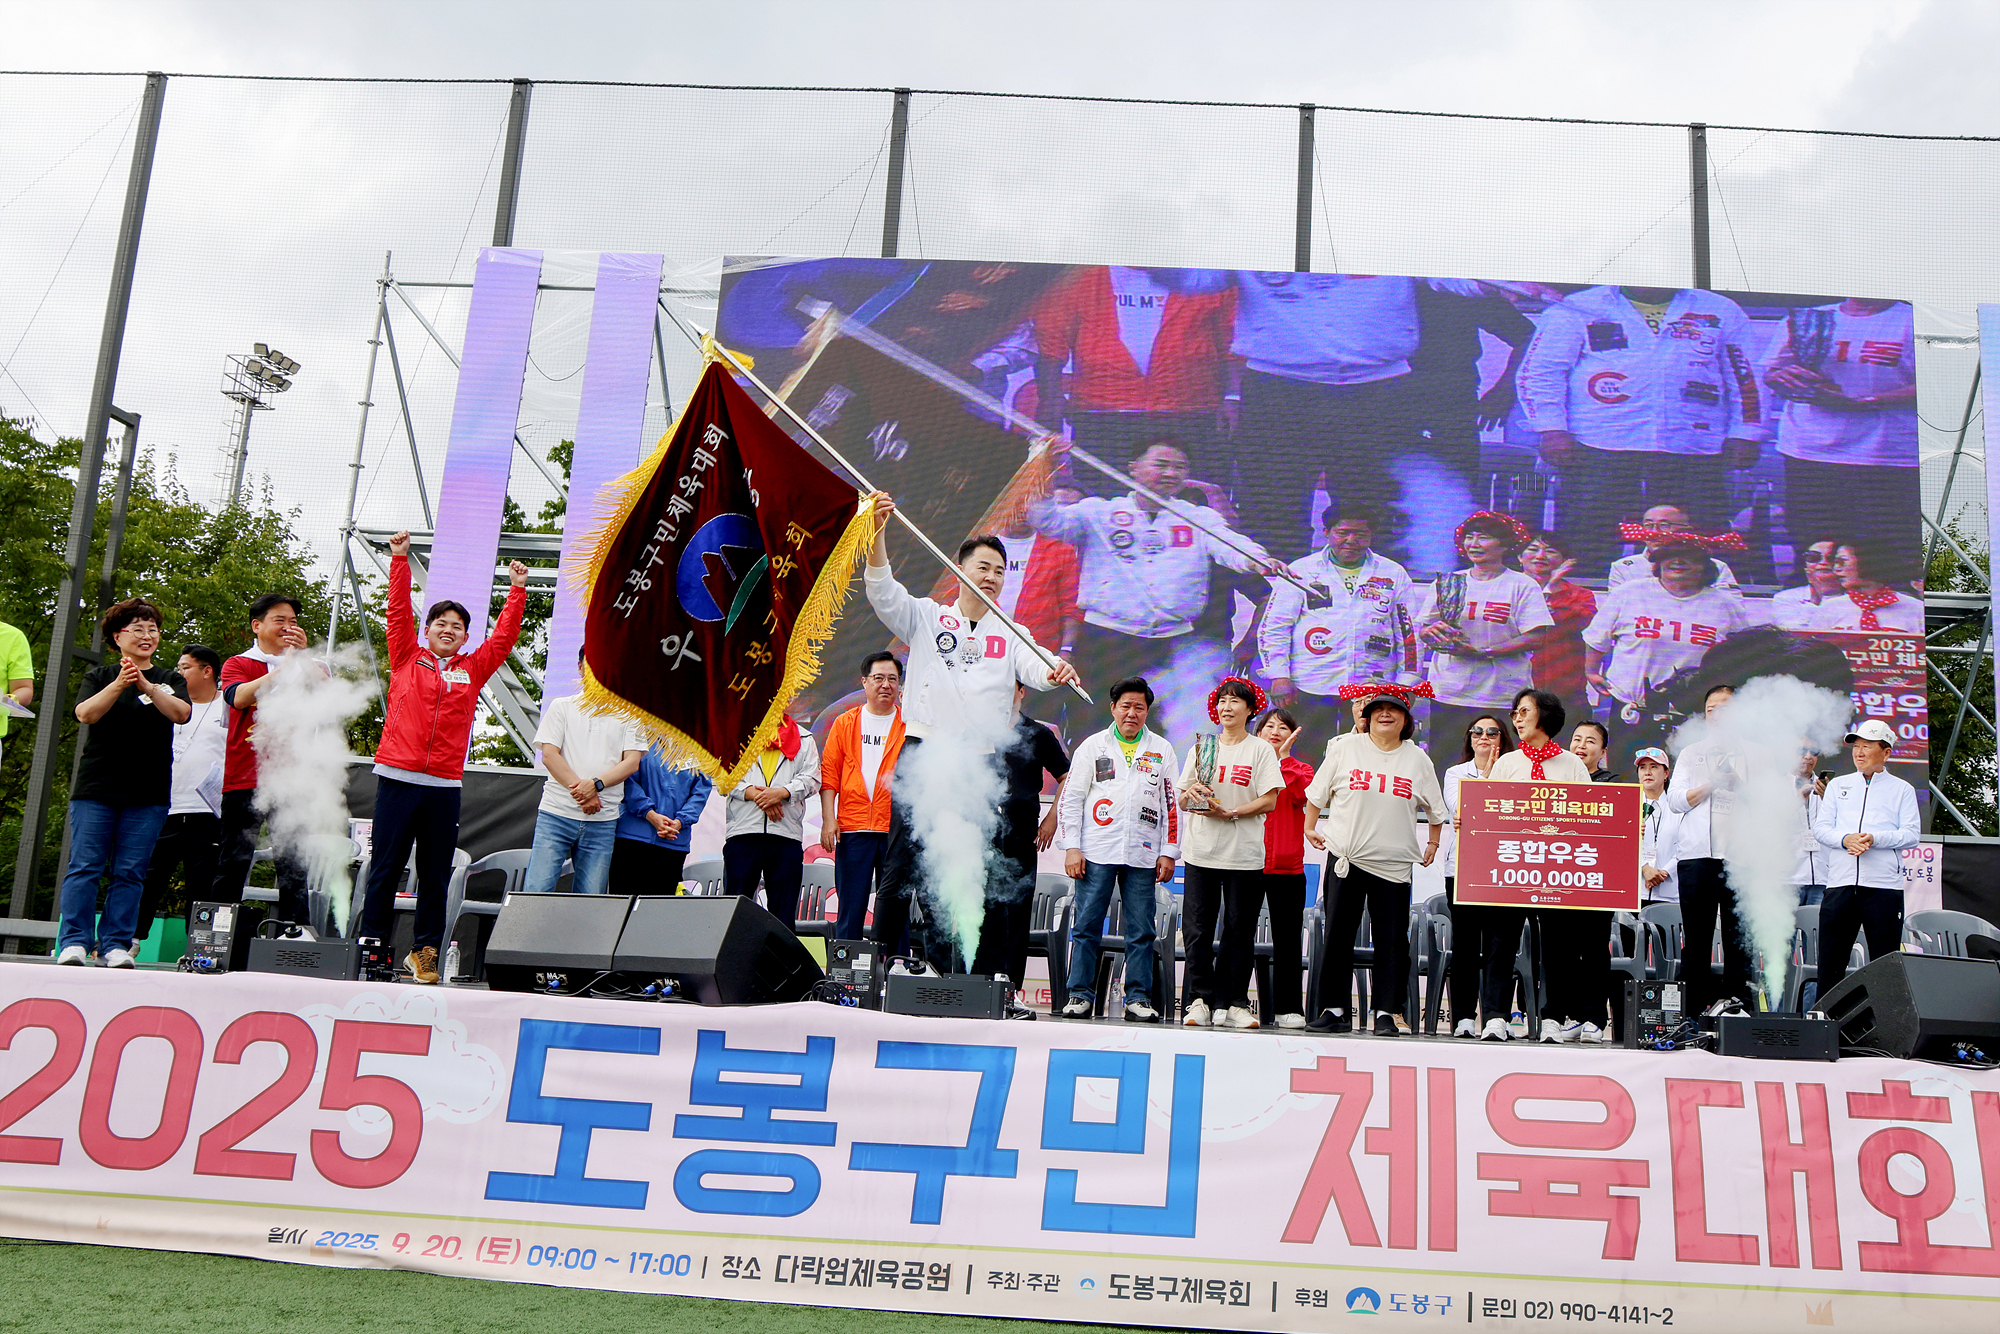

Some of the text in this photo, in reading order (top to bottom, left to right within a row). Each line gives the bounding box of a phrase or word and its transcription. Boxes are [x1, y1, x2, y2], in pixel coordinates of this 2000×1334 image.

[1835, 341, 1903, 367] 1동
[613, 423, 729, 618] 도봉구민체육대회
[1466, 601, 1511, 625] 1동
[1634, 616, 1717, 647] 창1동
[984, 635, 1007, 659] D
[1867, 639, 1918, 652] 2025
[1217, 764, 1253, 788] 1동
[1349, 768, 1413, 800] 창1동
[1530, 787, 1568, 800] 2025
[1484, 799, 1614, 817] 도봉구민 체육대회
[1497, 840, 1599, 866] 종합우승
[1489, 868, 1604, 889] 1,000,000원
[0, 998, 2000, 1278] 2025 도봉구민 체육대회
[267, 1227, 308, 1246] 일시
[315, 1230, 379, 1250] 2025.
[391, 1232, 411, 1255] 9.
[421, 1235, 463, 1260] 20.
[475, 1235, 521, 1265] (토)
[526, 1245, 597, 1271] 09:00
[629, 1251, 692, 1277] 17:00
[722, 1254, 951, 1292] 장소 다락원체육공원
[987, 1270, 1251, 1307] 주최·주관 도봉구체육회
[1294, 1287, 1453, 1315] 후원 도봉구
[1482, 1298, 1674, 1325] 문의 02) 990-4141~2
